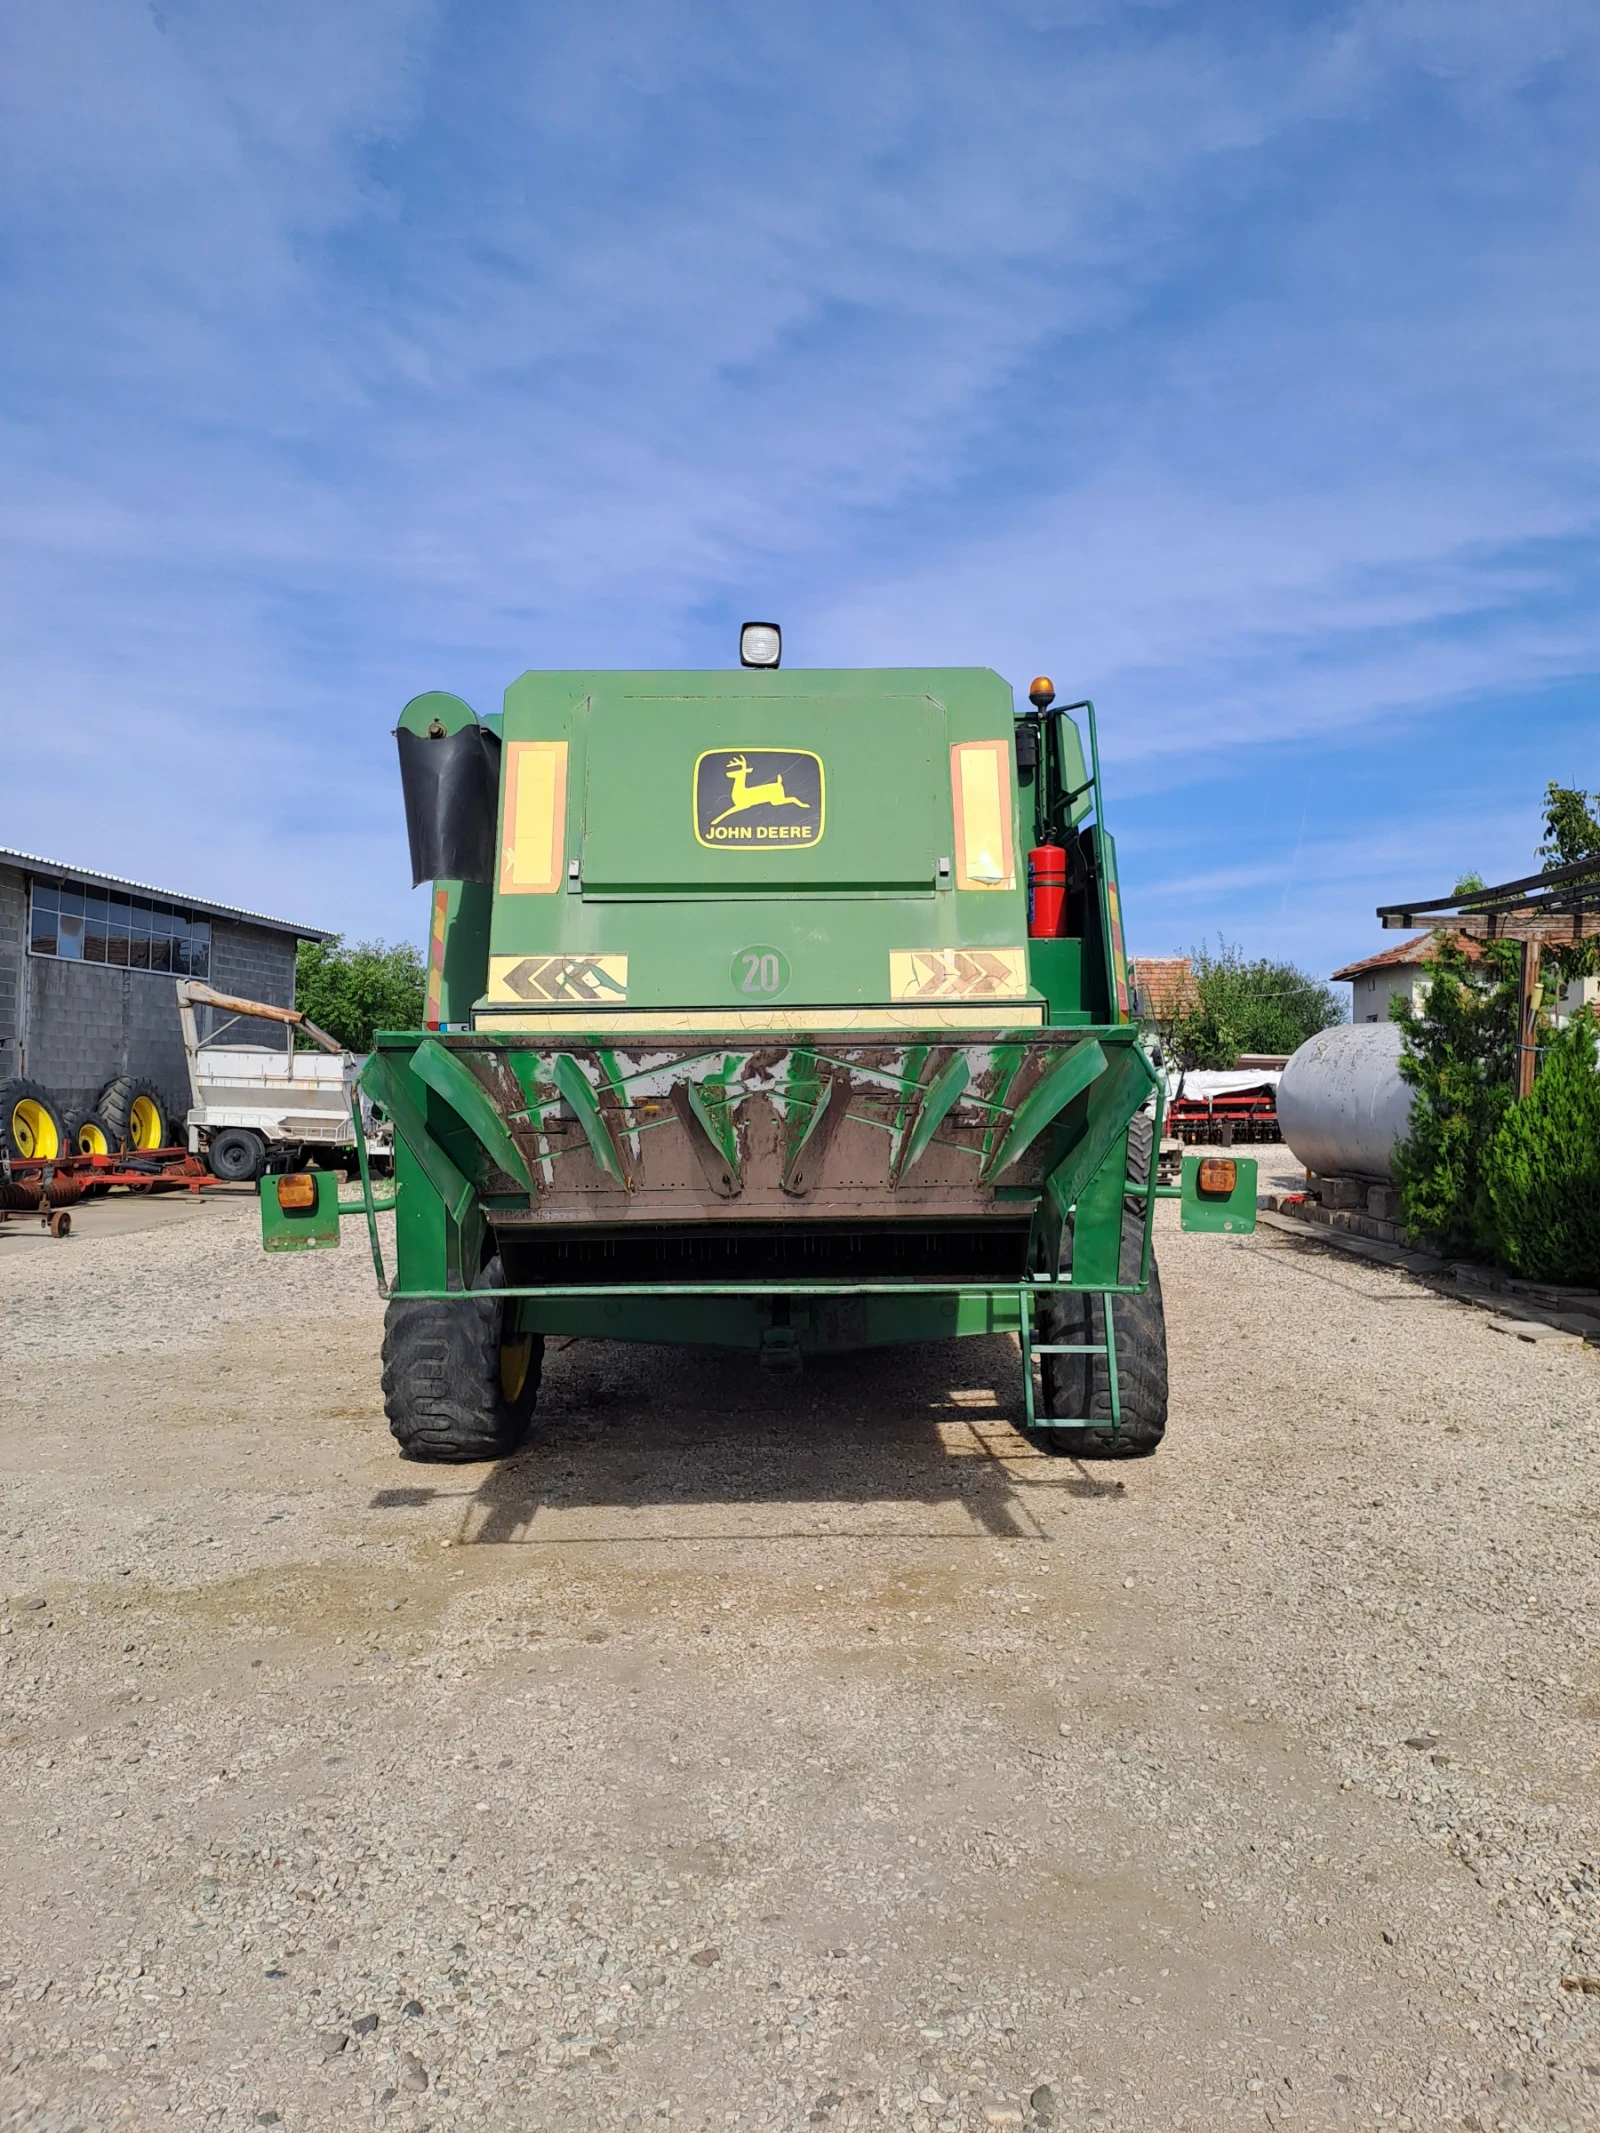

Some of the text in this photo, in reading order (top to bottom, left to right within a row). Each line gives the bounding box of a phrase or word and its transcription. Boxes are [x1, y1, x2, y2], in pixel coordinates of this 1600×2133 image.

[705, 826, 812, 840] JOHN DEERE
[741, 954, 779, 992] 20
